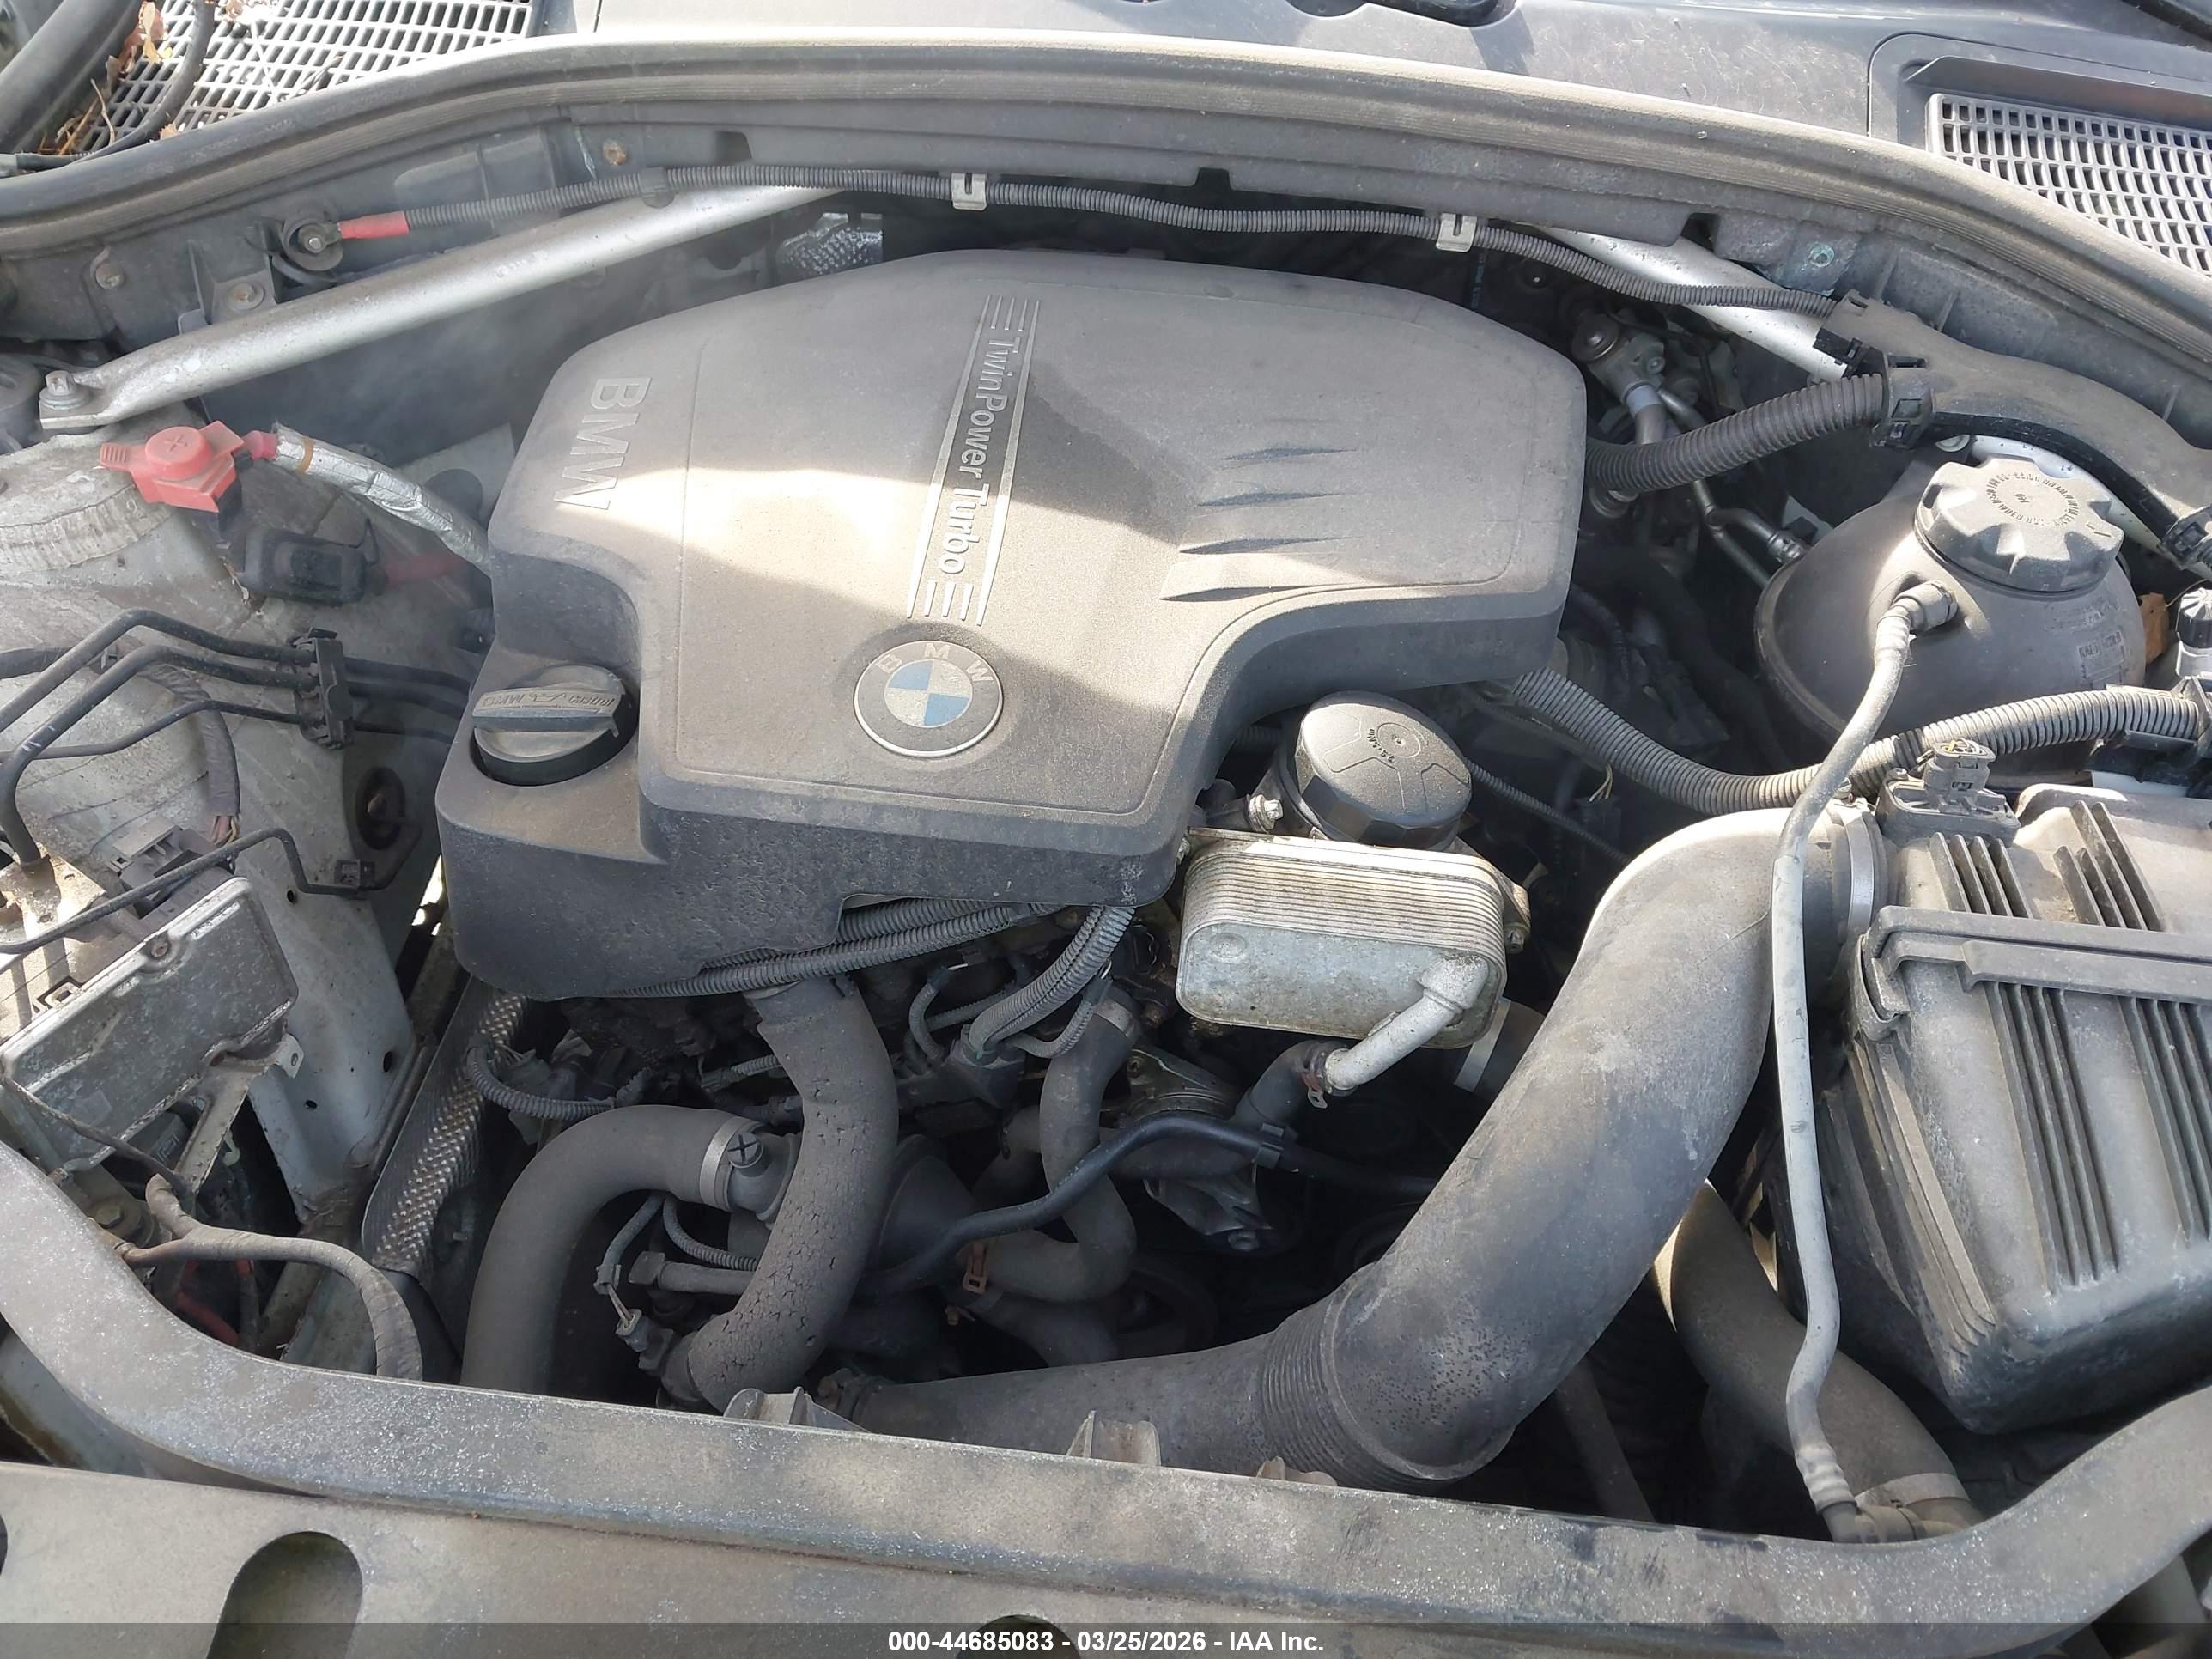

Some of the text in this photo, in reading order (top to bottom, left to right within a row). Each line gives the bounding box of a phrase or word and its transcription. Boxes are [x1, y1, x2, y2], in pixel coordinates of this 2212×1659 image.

[552, 377, 653, 510] BMW
[938, 337, 1021, 575] TwinPower Turbo
[482, 694, 526, 708] BMW
[875, 642, 994, 683] BMW
